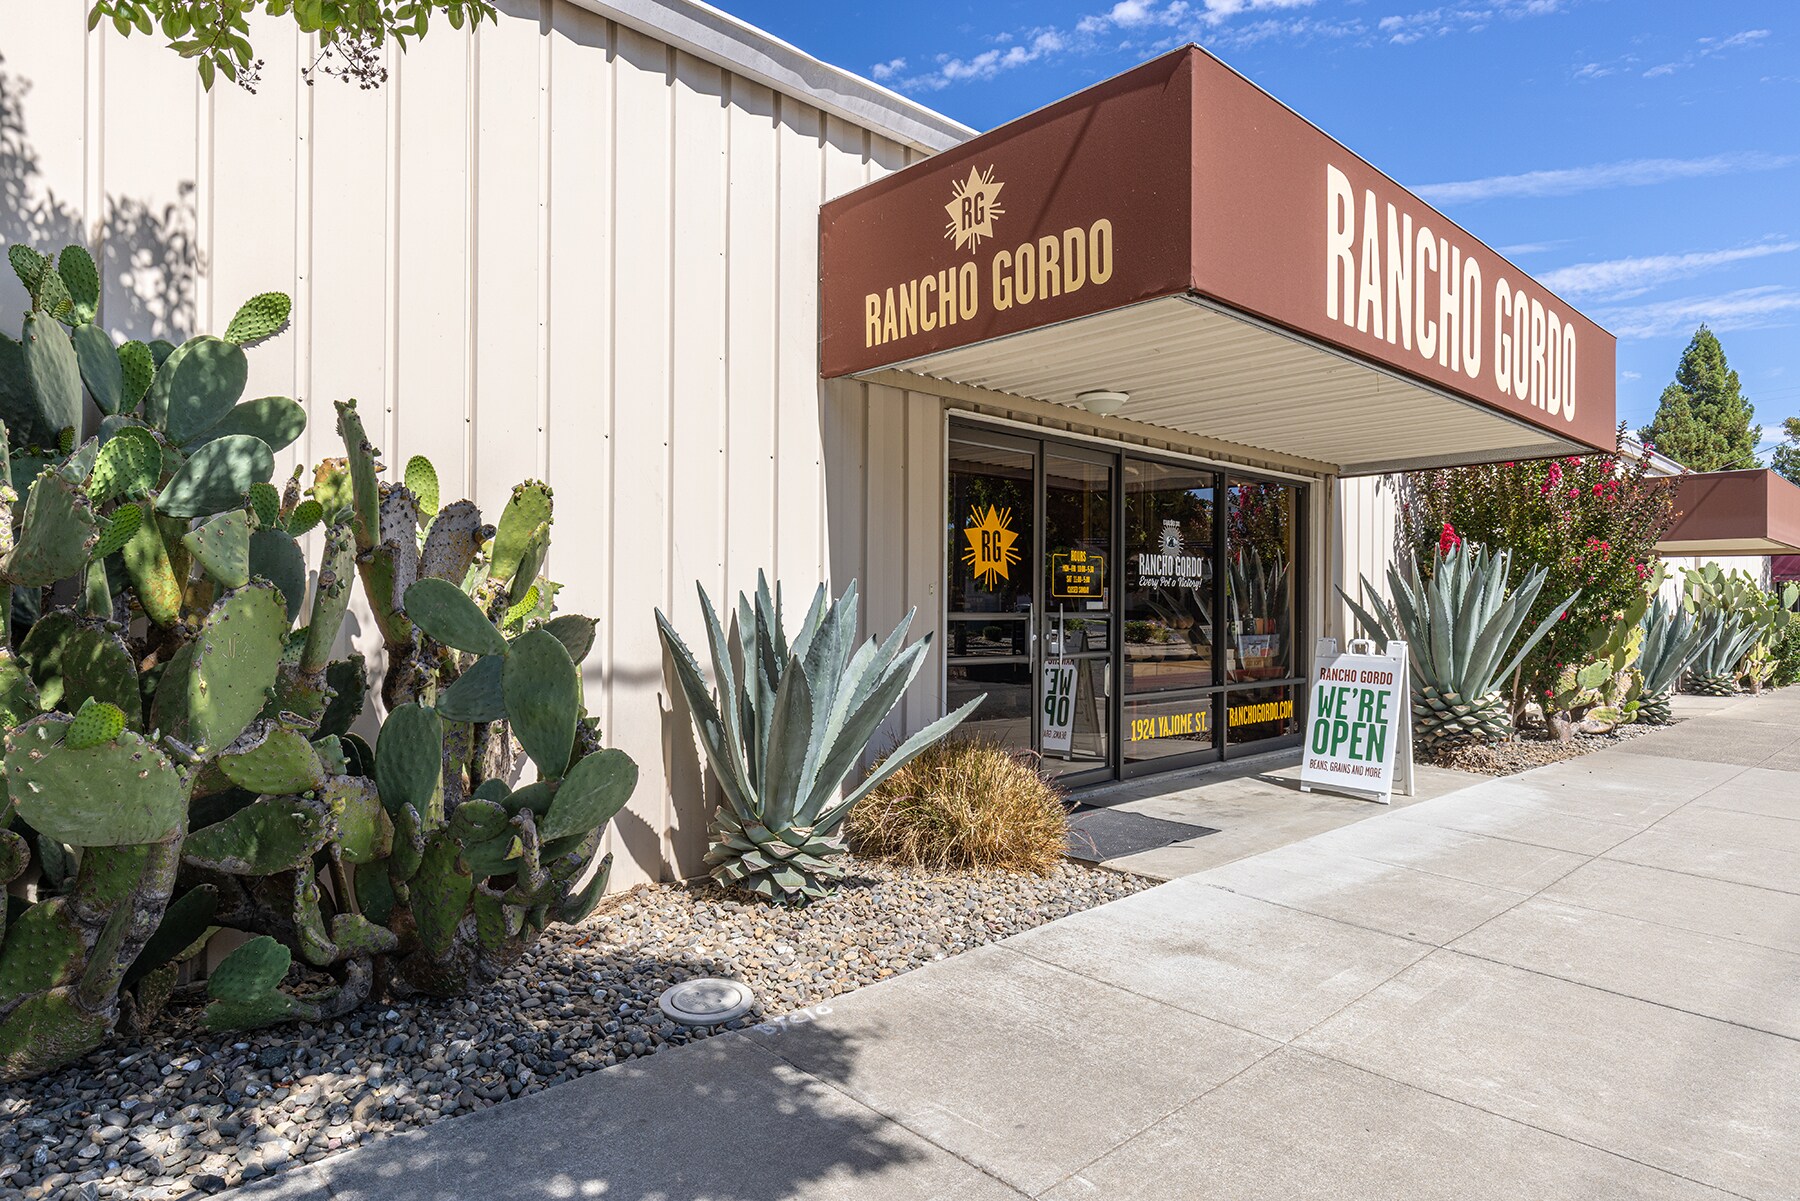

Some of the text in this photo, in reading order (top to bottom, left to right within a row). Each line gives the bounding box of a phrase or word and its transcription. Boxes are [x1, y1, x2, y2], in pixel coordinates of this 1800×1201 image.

[961, 190, 986, 232] RG
[865, 218, 1113, 348] RANCHO GORDO
[1326, 163, 1577, 422] RANCHO GORDO
[981, 530, 1002, 563] RG
[1138, 553, 1202, 578] RANCHO GORDO
[1138, 575, 1159, 590] Every
[1160, 576, 1172, 587] Pot
[1320, 667, 1393, 685] RANCHO GORDO
[1229, 700, 1294, 727] RANCHOGORDO.COM
[1317, 685, 1391, 724] WE'RE
[1131, 711, 1208, 742] 1924 YAJOME ST.
[1312, 718, 1387, 763] OPEN
[1309, 759, 1382, 779] BEANS, GRAINS AND MORE
